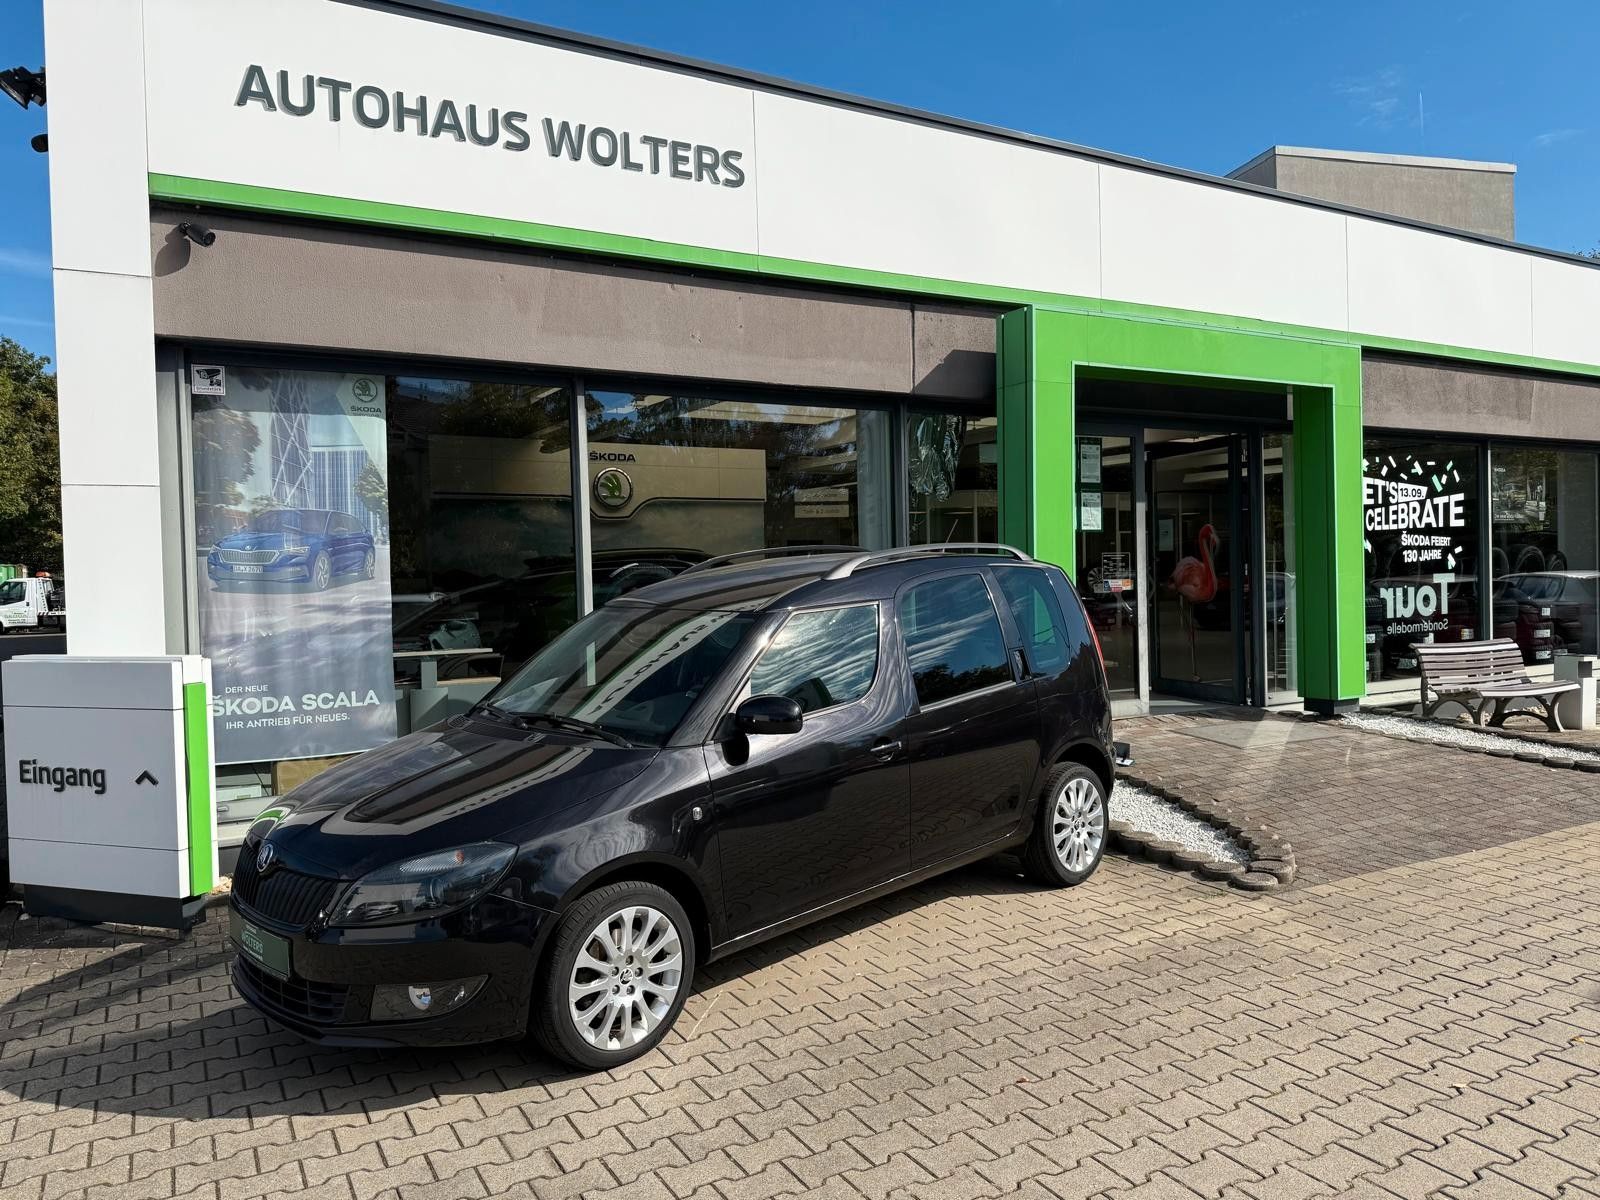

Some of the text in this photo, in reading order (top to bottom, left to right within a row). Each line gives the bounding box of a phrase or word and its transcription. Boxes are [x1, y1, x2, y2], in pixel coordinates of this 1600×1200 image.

[235, 64, 746, 188] AUTOHAUS WOLTERS
[350, 405, 382, 413] ŠKODA
[589, 451, 636, 462] ŠKODA
[1363, 477, 1398, 505] ET'S
[1400, 487, 1425, 499] 13.09.
[1365, 493, 1465, 531] CELEBRATE
[1401, 531, 1451, 546] ŠKODA FEIERT
[1403, 549, 1442, 563] 130 JAHRE
[225, 684, 269, 694] DER NEUE
[212, 689, 381, 717] ŠKODA SCALA
[226, 712, 351, 730] IHR ANTRIEB FÜR NEUES.
[19, 759, 107, 795] Eingang
